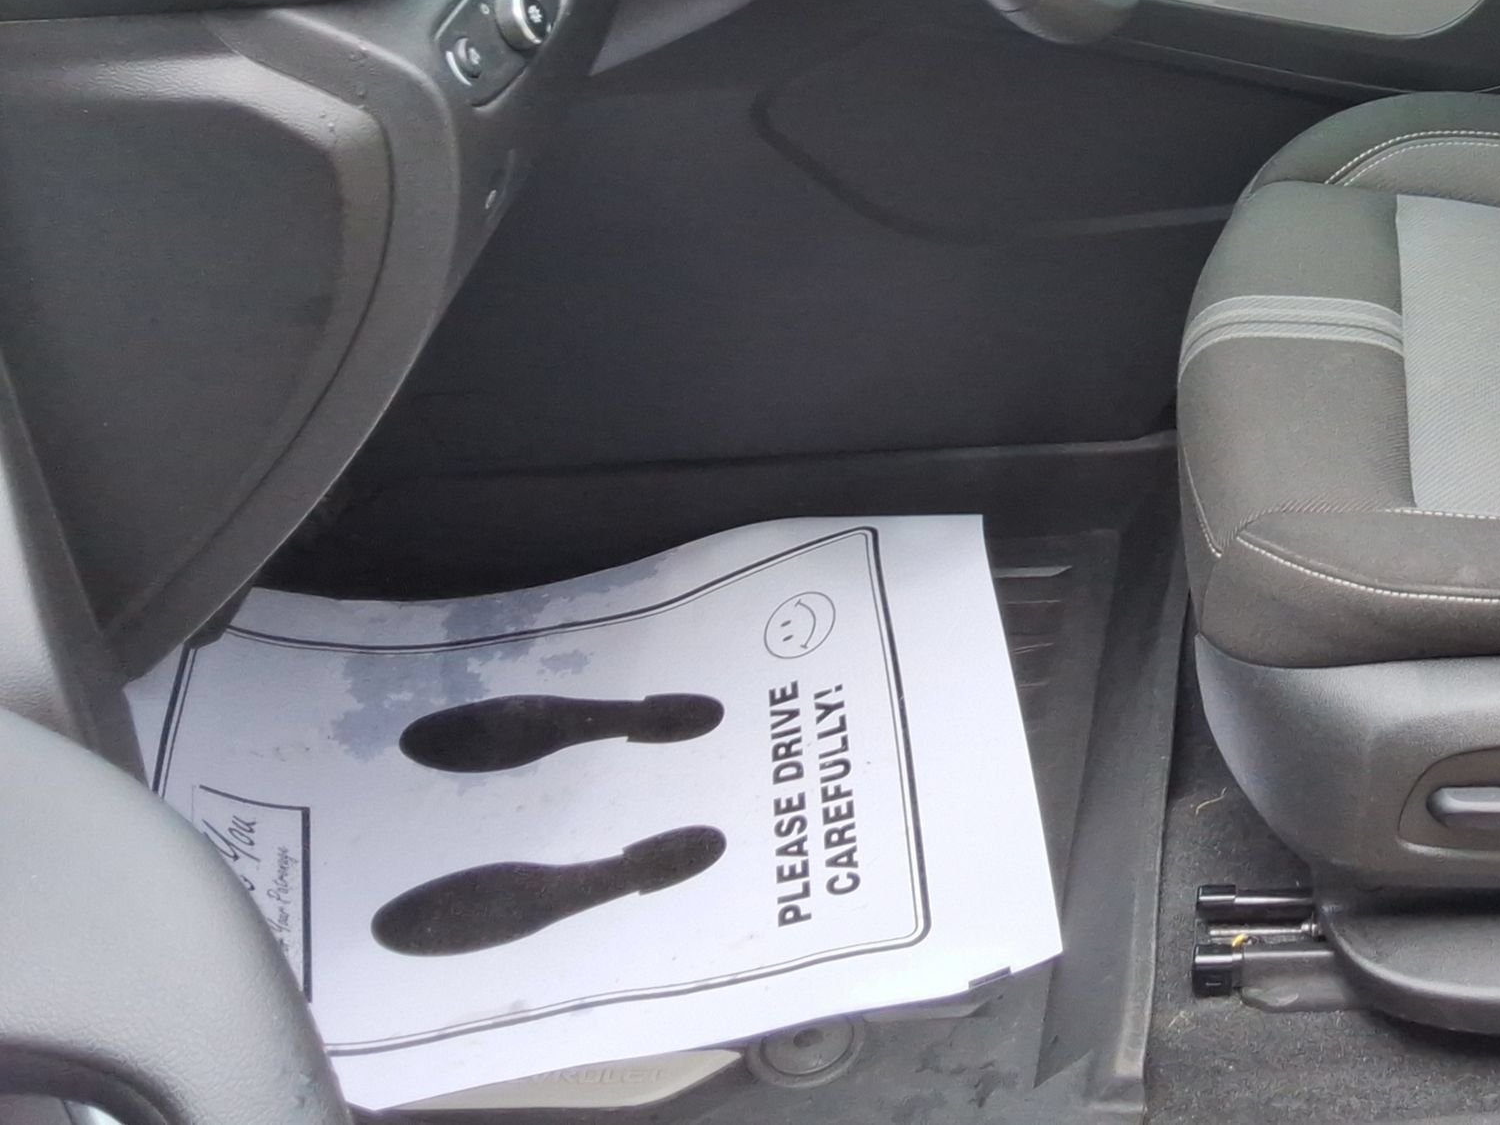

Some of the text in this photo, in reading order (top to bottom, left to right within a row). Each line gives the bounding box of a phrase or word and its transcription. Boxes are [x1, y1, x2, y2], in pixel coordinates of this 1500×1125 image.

[202, 814, 262, 862] You
[768, 680, 813, 928] PLEASE DRIVE
[813, 683, 861, 896] CAREFULLY!
